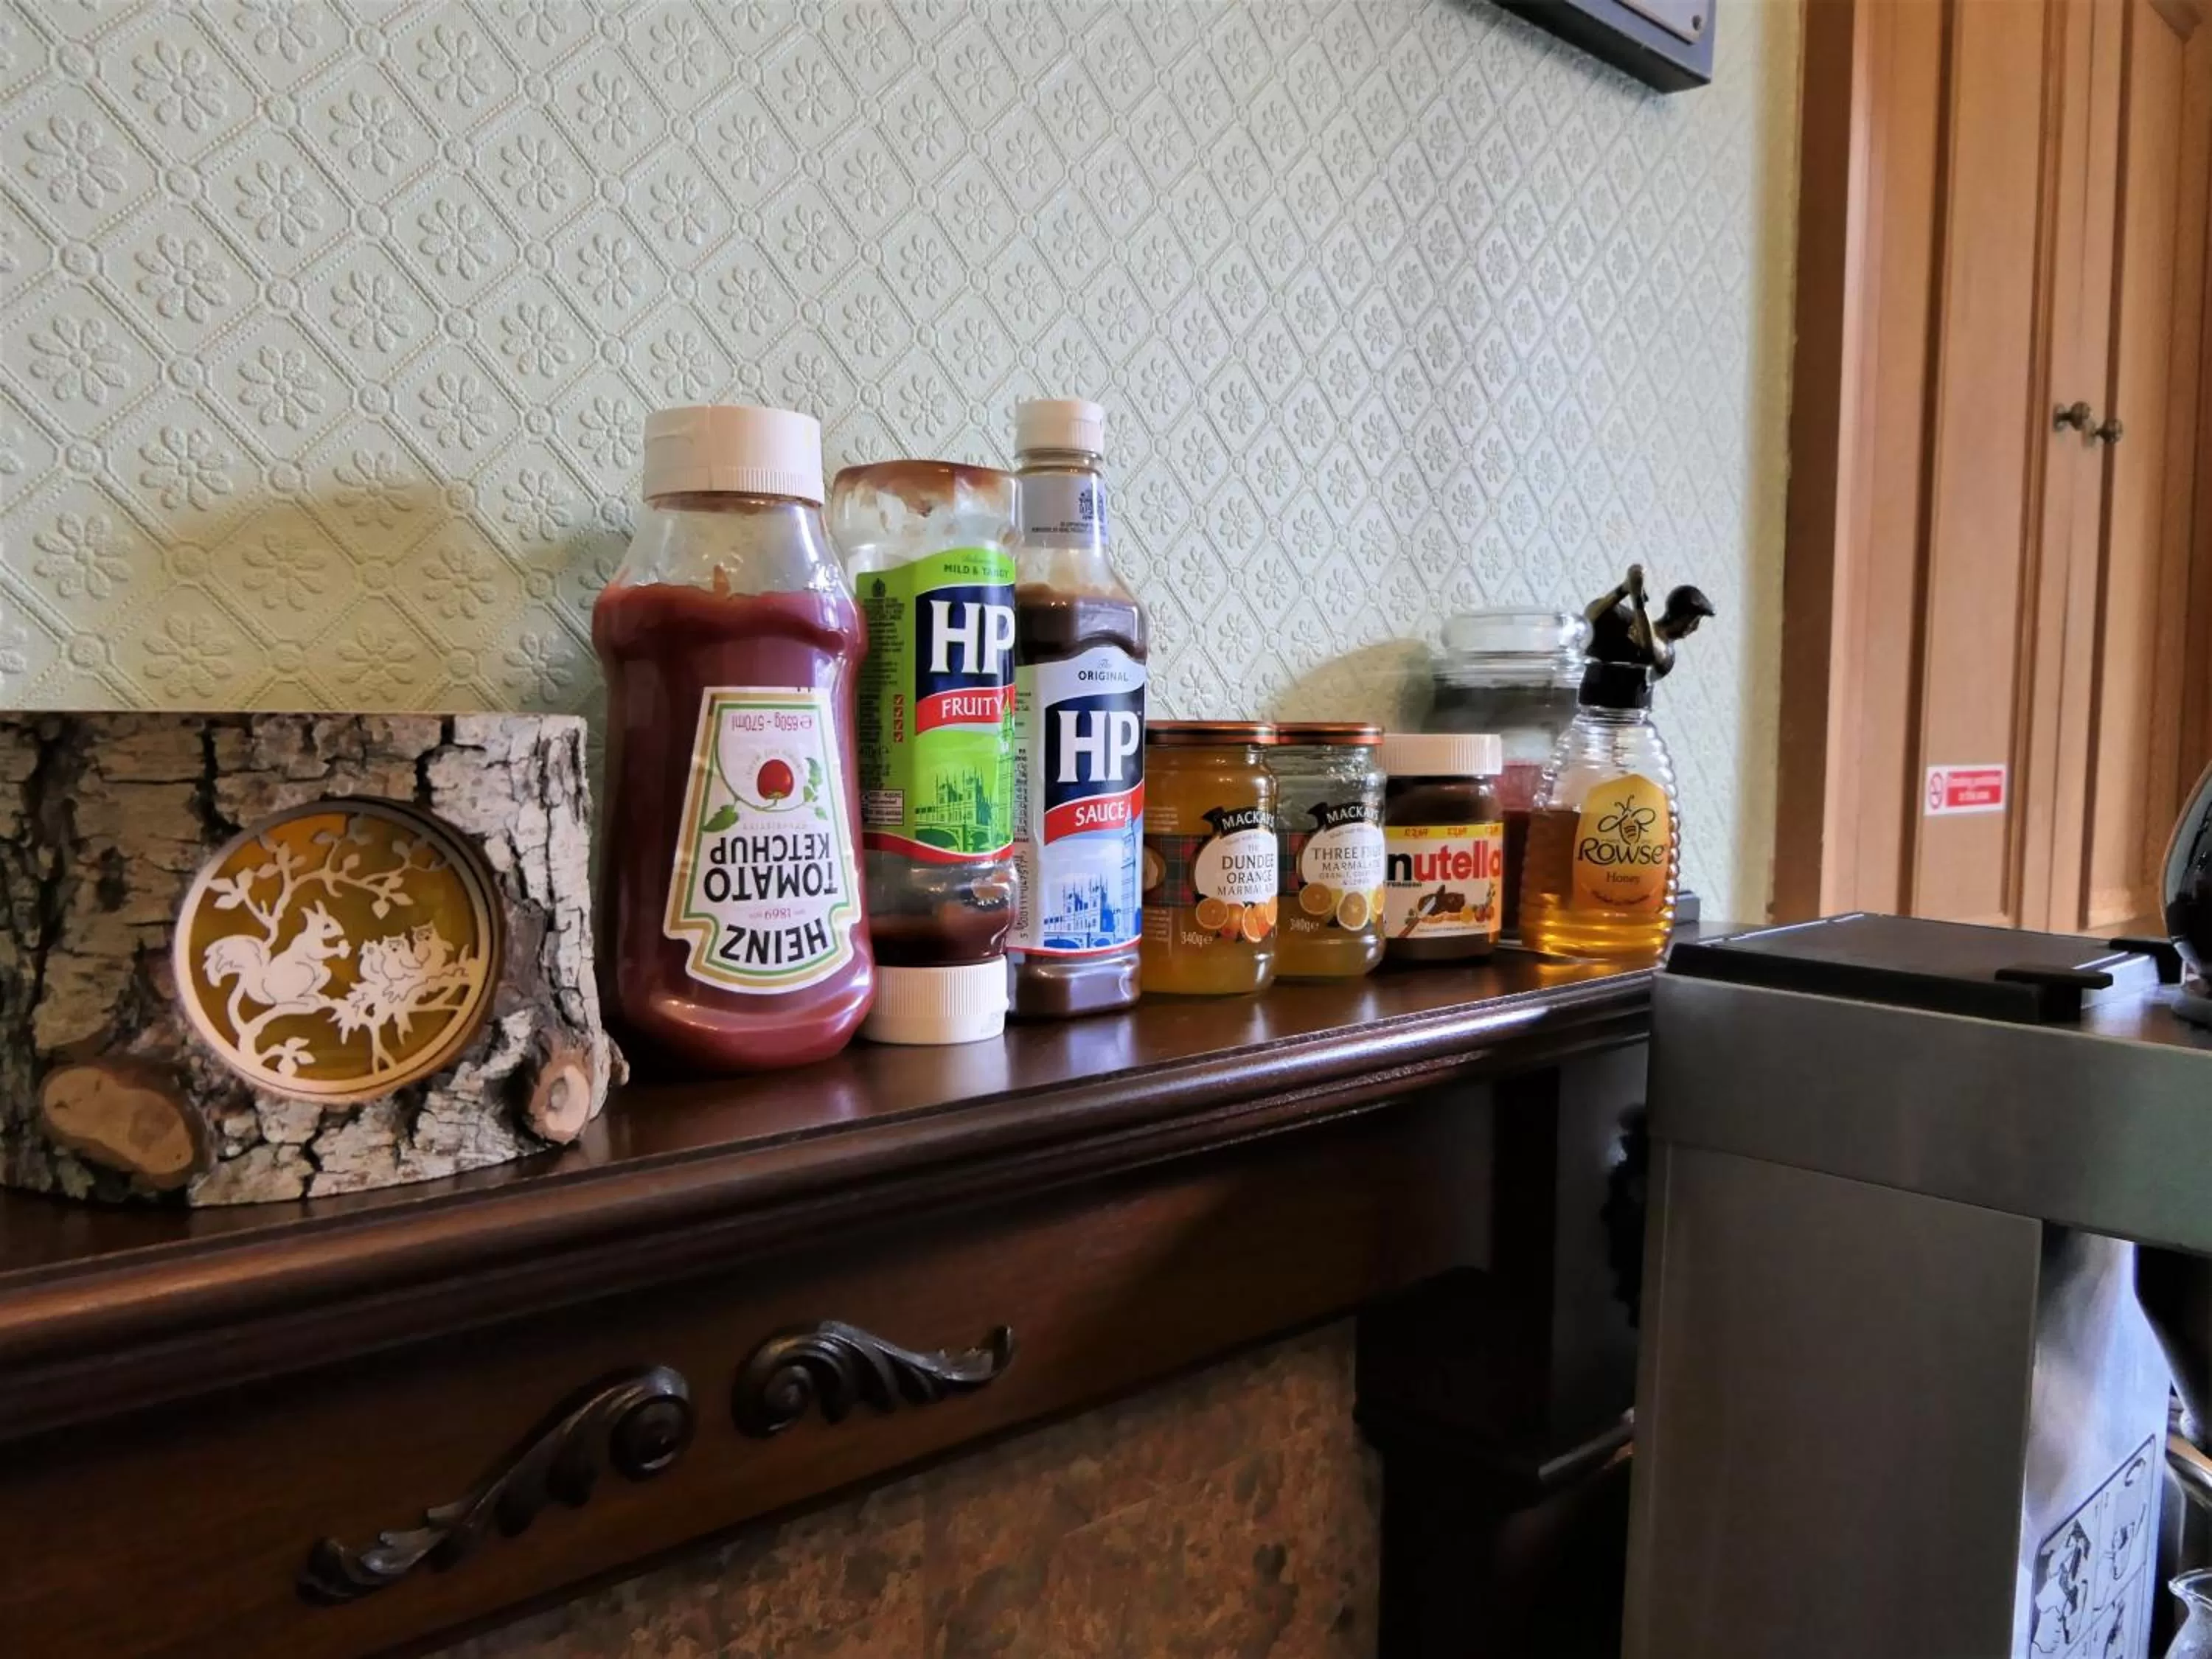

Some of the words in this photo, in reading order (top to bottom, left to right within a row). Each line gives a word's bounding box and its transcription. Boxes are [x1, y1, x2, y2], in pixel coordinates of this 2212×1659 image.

[944, 563, 970, 574] MILD
[930, 599, 1016, 675] HP
[1078, 670, 1130, 682] ORIGINAL
[942, 693, 1004, 720] FRUITY
[1057, 710, 1140, 783] HP
[1075, 800, 1126, 827] SAUCE
[710, 832, 830, 866] KETCHUP
[1312, 846, 1358, 860] THREE
[1387, 841, 1502, 882] nutella
[703, 861, 838, 903] TOMATO
[1607, 872, 1641, 884] Honey
[765, 908, 791, 921] 1869
[720, 917, 828, 964] HEINZ
[1180, 931, 1204, 948] 340g
